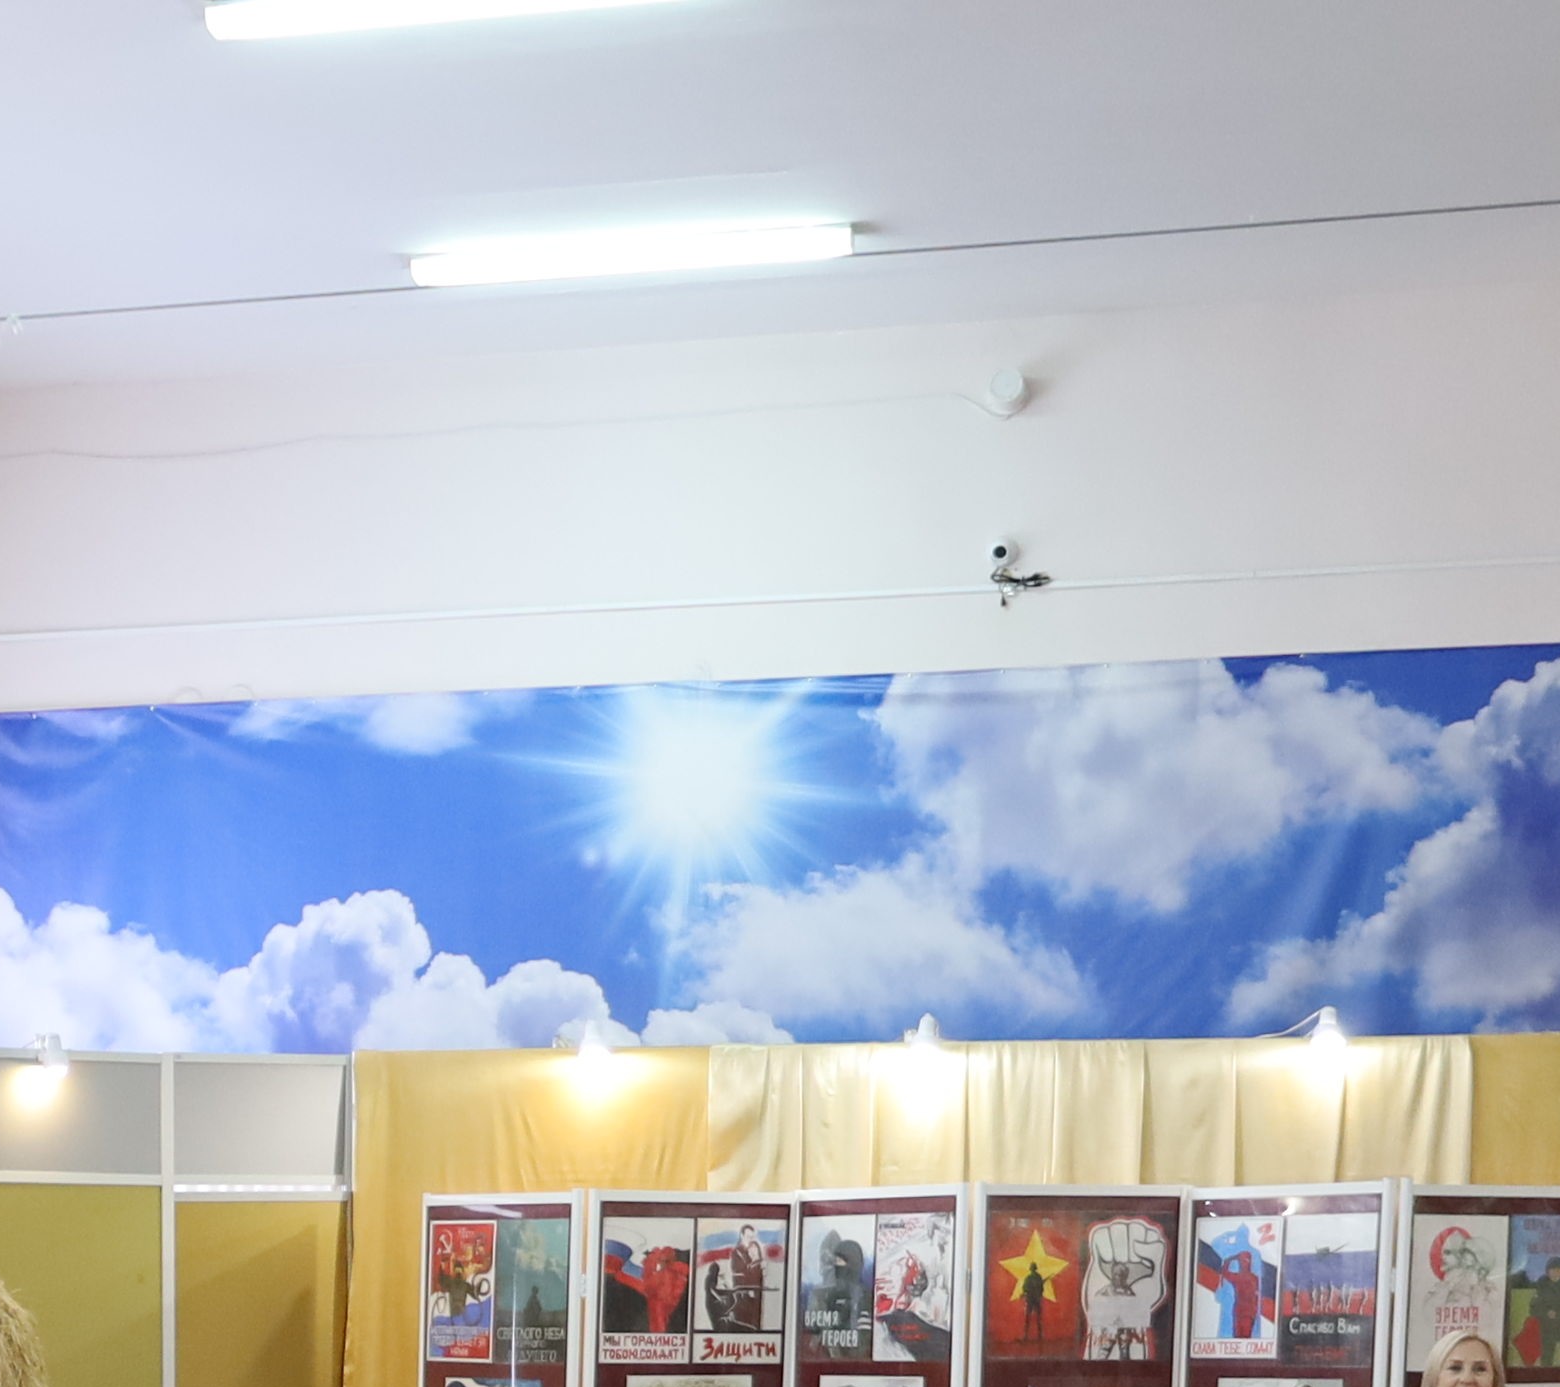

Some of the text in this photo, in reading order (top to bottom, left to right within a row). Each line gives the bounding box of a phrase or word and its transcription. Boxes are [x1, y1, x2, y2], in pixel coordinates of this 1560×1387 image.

[804, 1310, 839, 1327] ВРЕМЯ
[602, 1335, 686, 1347] МЫ ГОРДИМСЯ
[821, 1329, 859, 1347] ГЕРОЕВ
